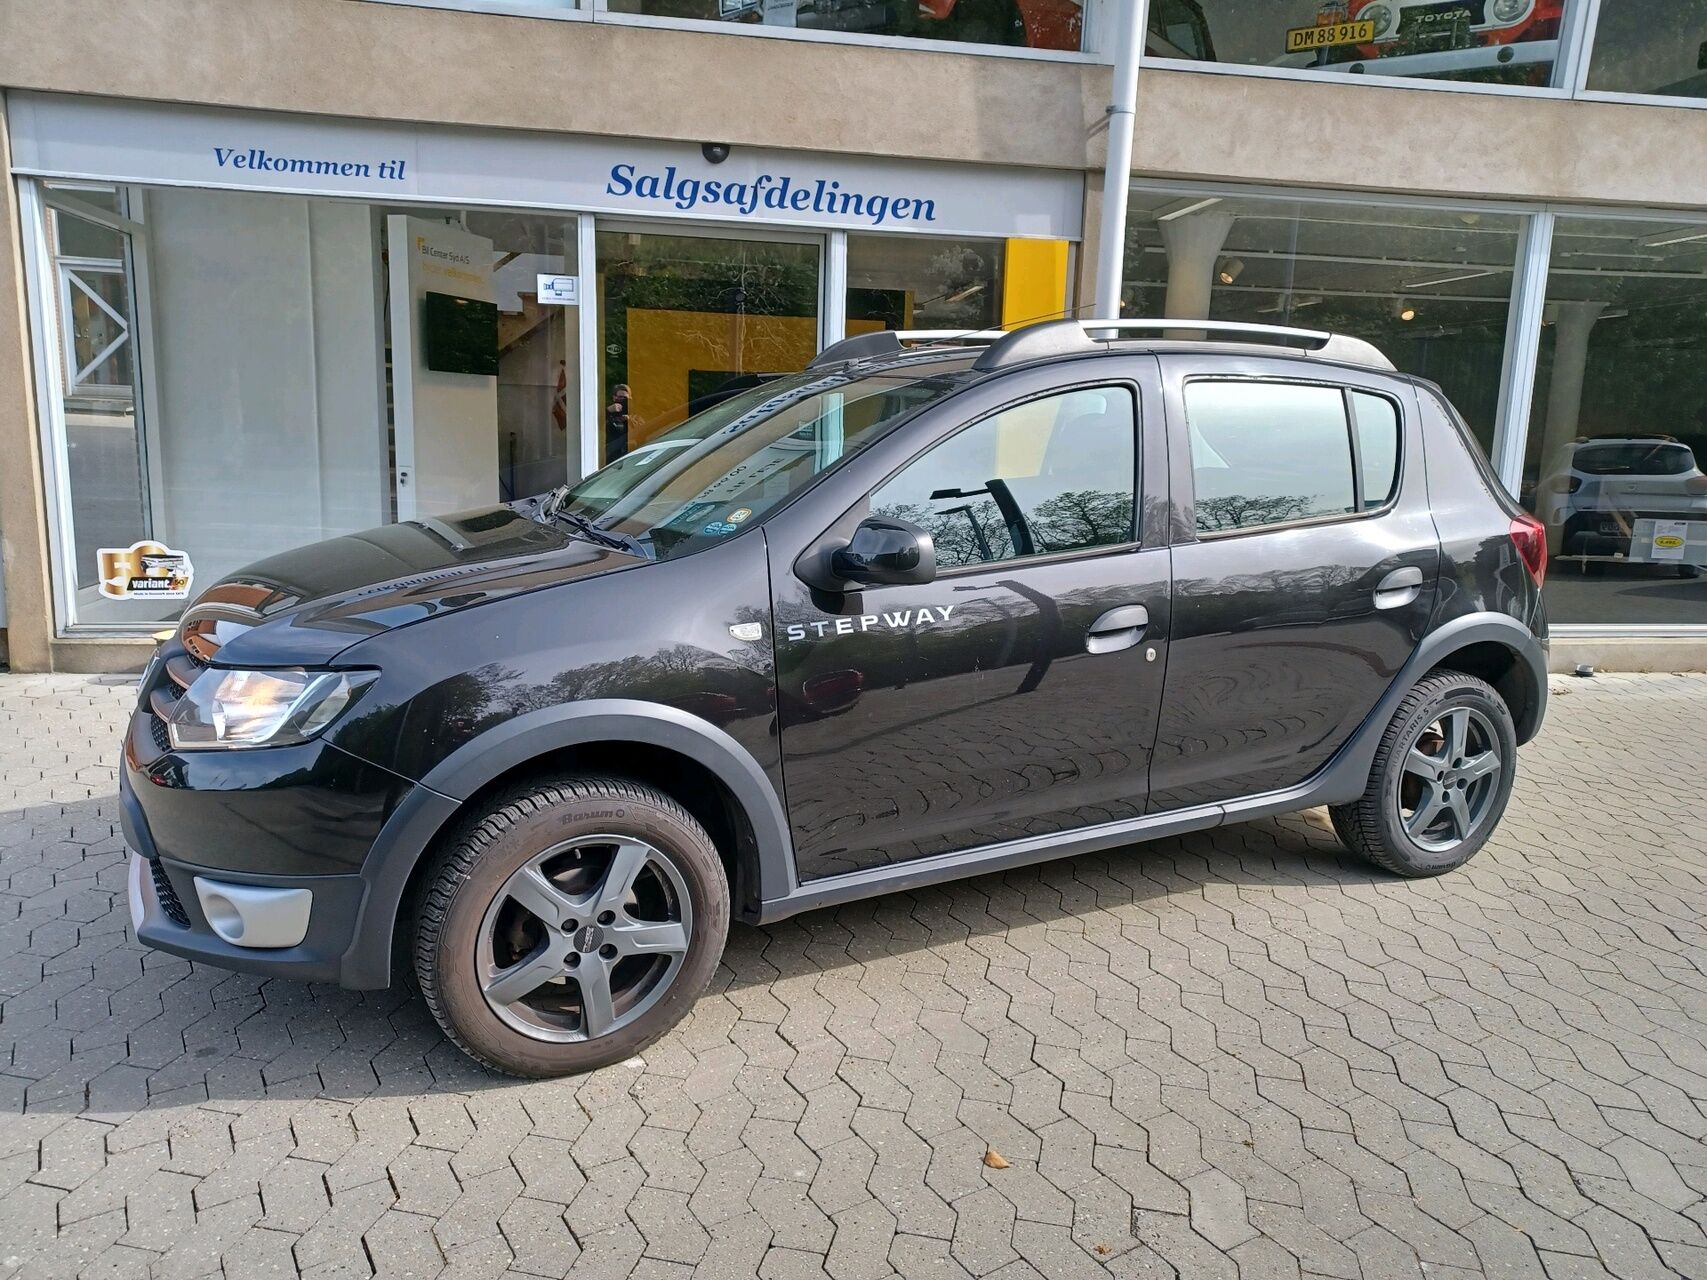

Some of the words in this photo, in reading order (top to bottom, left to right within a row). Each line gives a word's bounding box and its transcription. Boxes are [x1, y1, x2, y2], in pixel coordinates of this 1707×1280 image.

[1415, 9, 1472, 23] TOYOTA
[1294, 31, 1315, 47] DM
[1317, 28, 1336, 44] 88
[1340, 23, 1368, 40] 916
[213, 147, 371, 178] Velkommen
[378, 160, 406, 180] til
[606, 164, 936, 225] Salgsafdelingen
[132, 578, 169, 589] variant
[787, 605, 955, 642] STEPWAY
[561, 809, 613, 826] Barum
